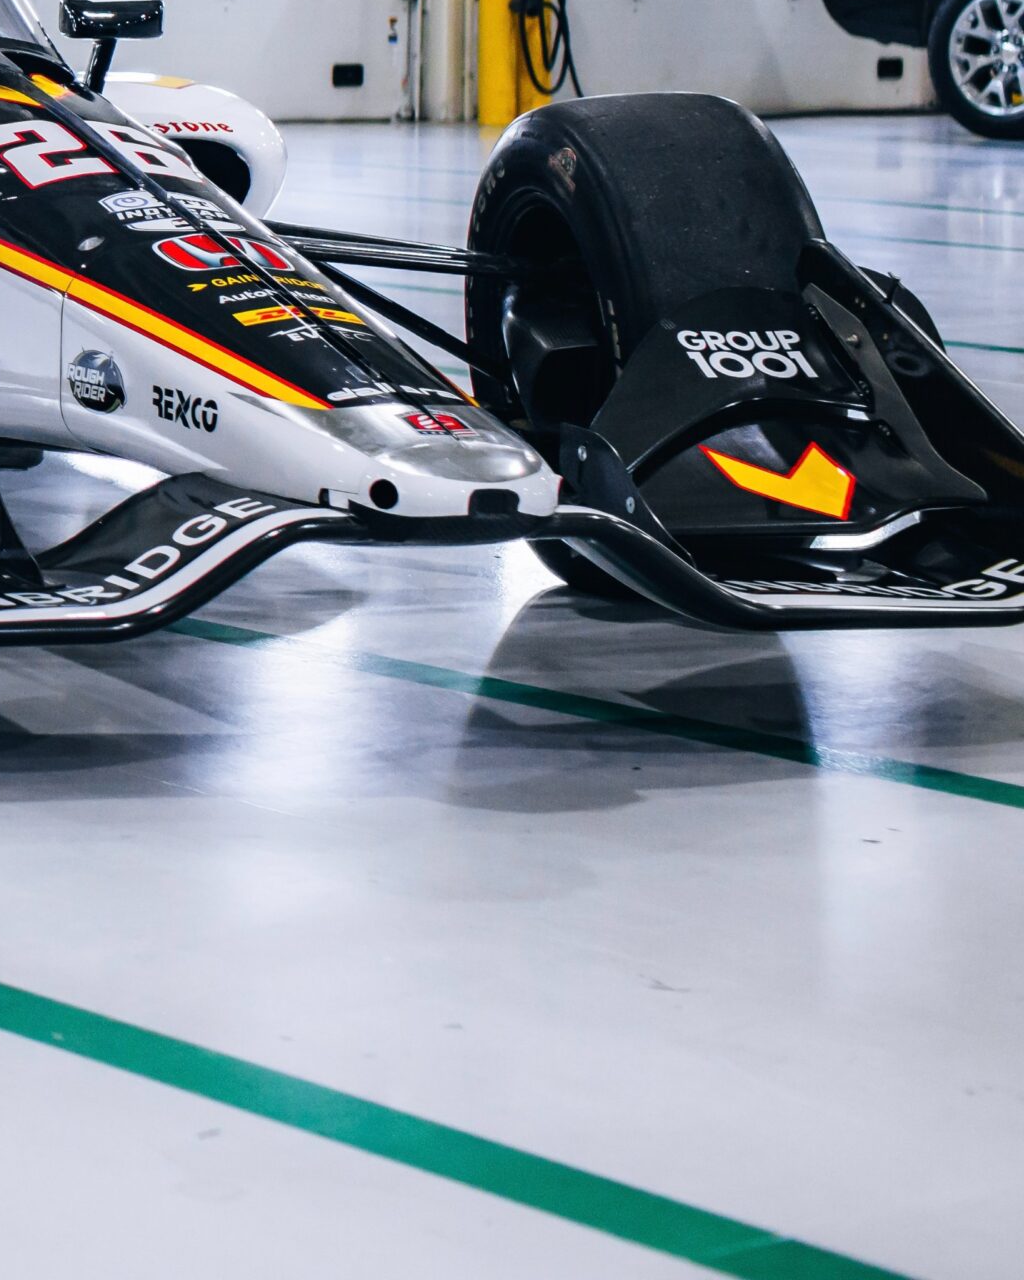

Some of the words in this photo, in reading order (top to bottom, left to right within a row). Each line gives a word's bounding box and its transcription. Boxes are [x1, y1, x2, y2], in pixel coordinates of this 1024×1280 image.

[211, 274, 328, 291] GAINRIDGE
[219, 288, 338, 305] AutoNtion
[286, 329, 374, 342] EVEC
[677, 329, 800, 352] GROUP
[67, 363, 105, 386] ROUGH
[686, 351, 818, 378] 1001
[74, 380, 106, 402] RIDER
[152, 385, 218, 433] REXCO
